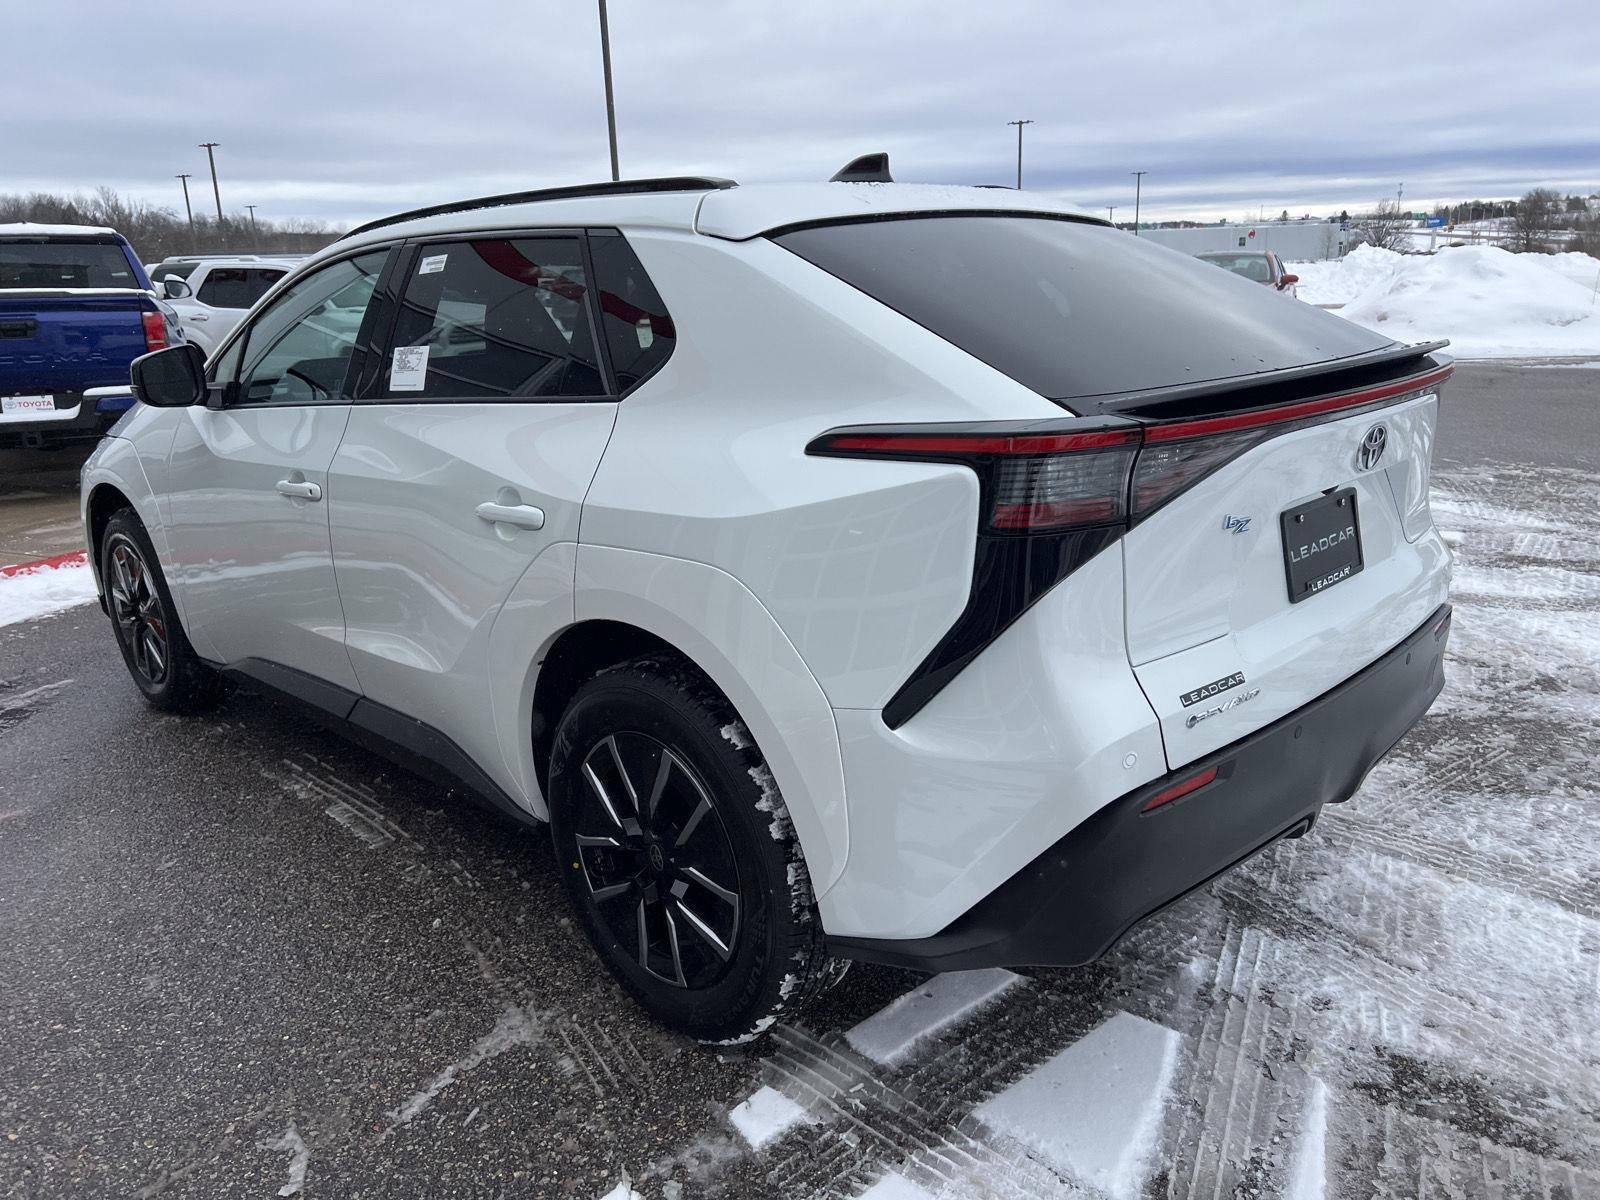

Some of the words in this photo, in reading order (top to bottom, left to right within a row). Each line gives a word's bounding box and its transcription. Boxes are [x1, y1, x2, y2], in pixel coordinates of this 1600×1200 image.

[18, 400, 53, 408] TOYOTA
[1290, 526, 1355, 562] LEADCAR
[1311, 568, 1350, 591] LEADCAR
[1181, 673, 1245, 705] LEADCAR
